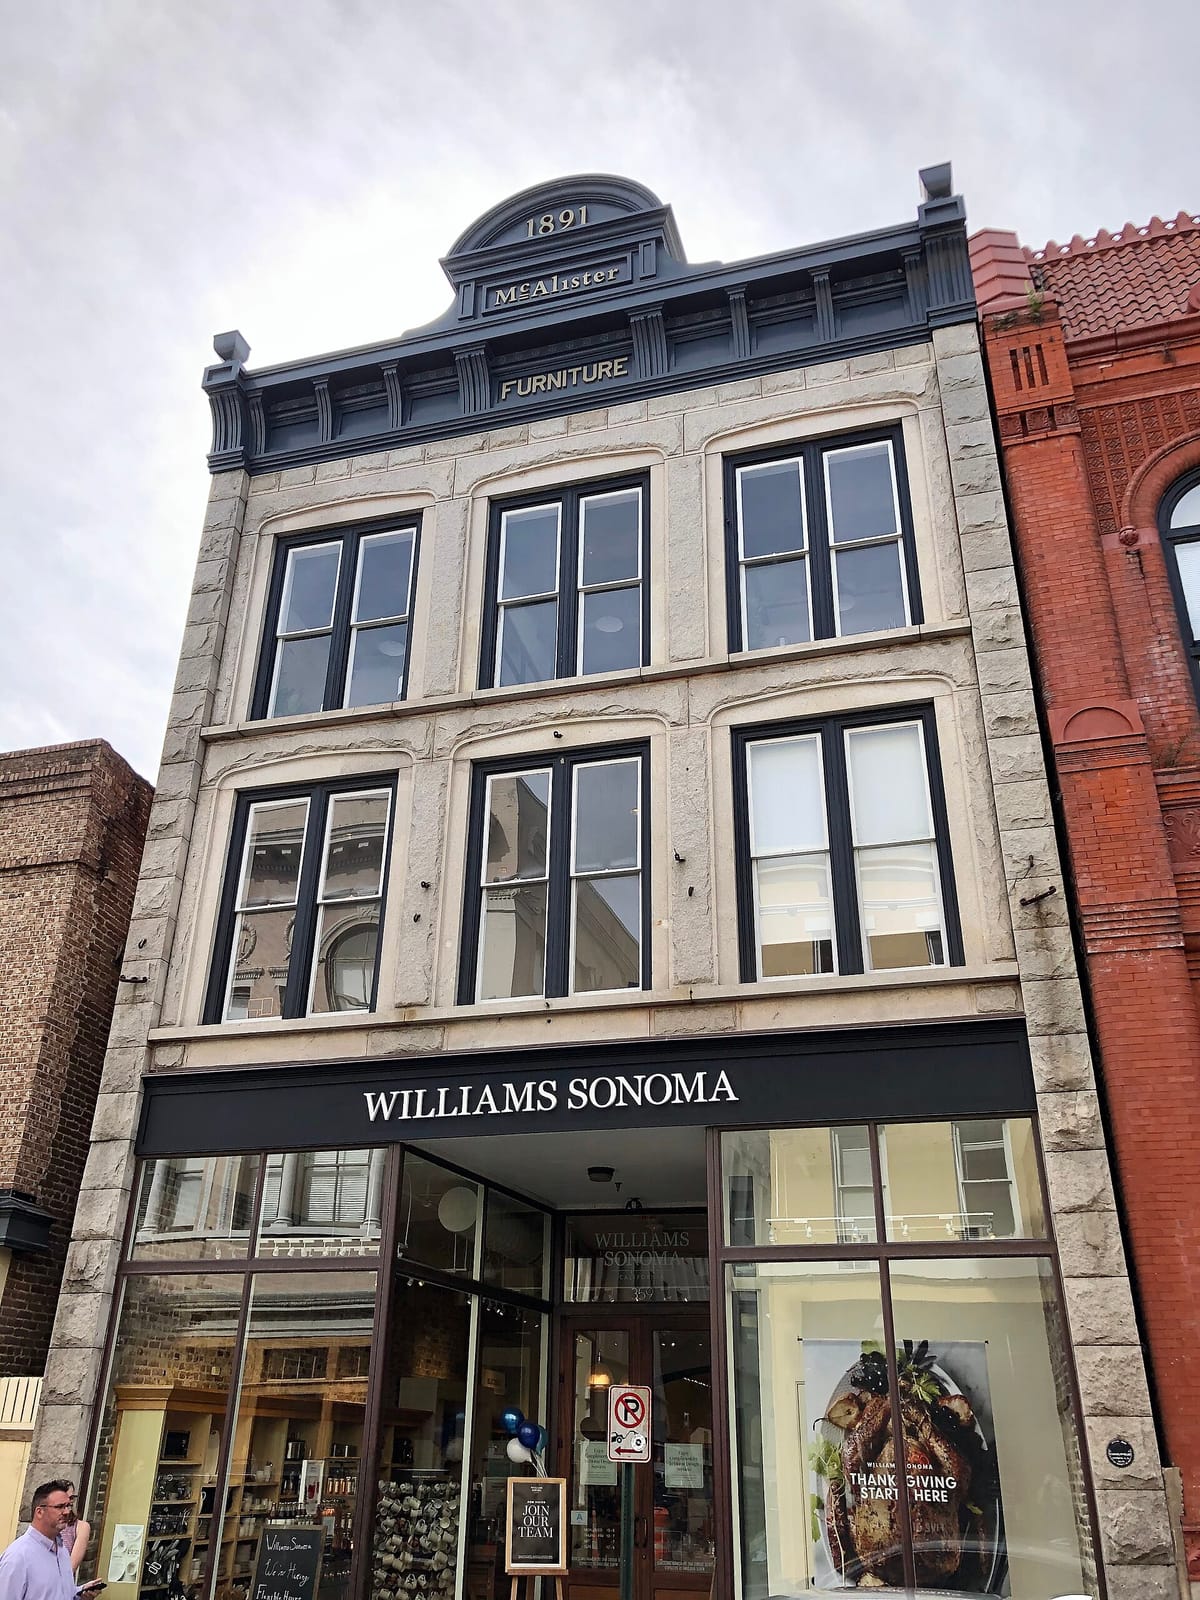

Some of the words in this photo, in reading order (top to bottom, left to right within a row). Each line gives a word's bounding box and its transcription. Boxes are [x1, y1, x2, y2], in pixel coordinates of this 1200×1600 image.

[526, 205, 588, 238] 1891
[494, 267, 620, 306] McAlister
[501, 357, 629, 400] FURNITURE
[363, 1080, 558, 1122] WILLIAMS
[567, 1070, 740, 1110] SONOMA
[594, 1231, 690, 1248] WILLIAMS
[604, 1250, 681, 1267] SONOMA
[631, 1287, 654, 1301] 359
[849, 1472, 957, 1490] THANKGIVING
[860, 1487, 899, 1500] START
[914, 1489, 948, 1502] HERE
[522, 1504, 550, 1516] JOIN
[523, 1515, 549, 1527] OUR
[517, 1526, 553, 1538] TEAM
